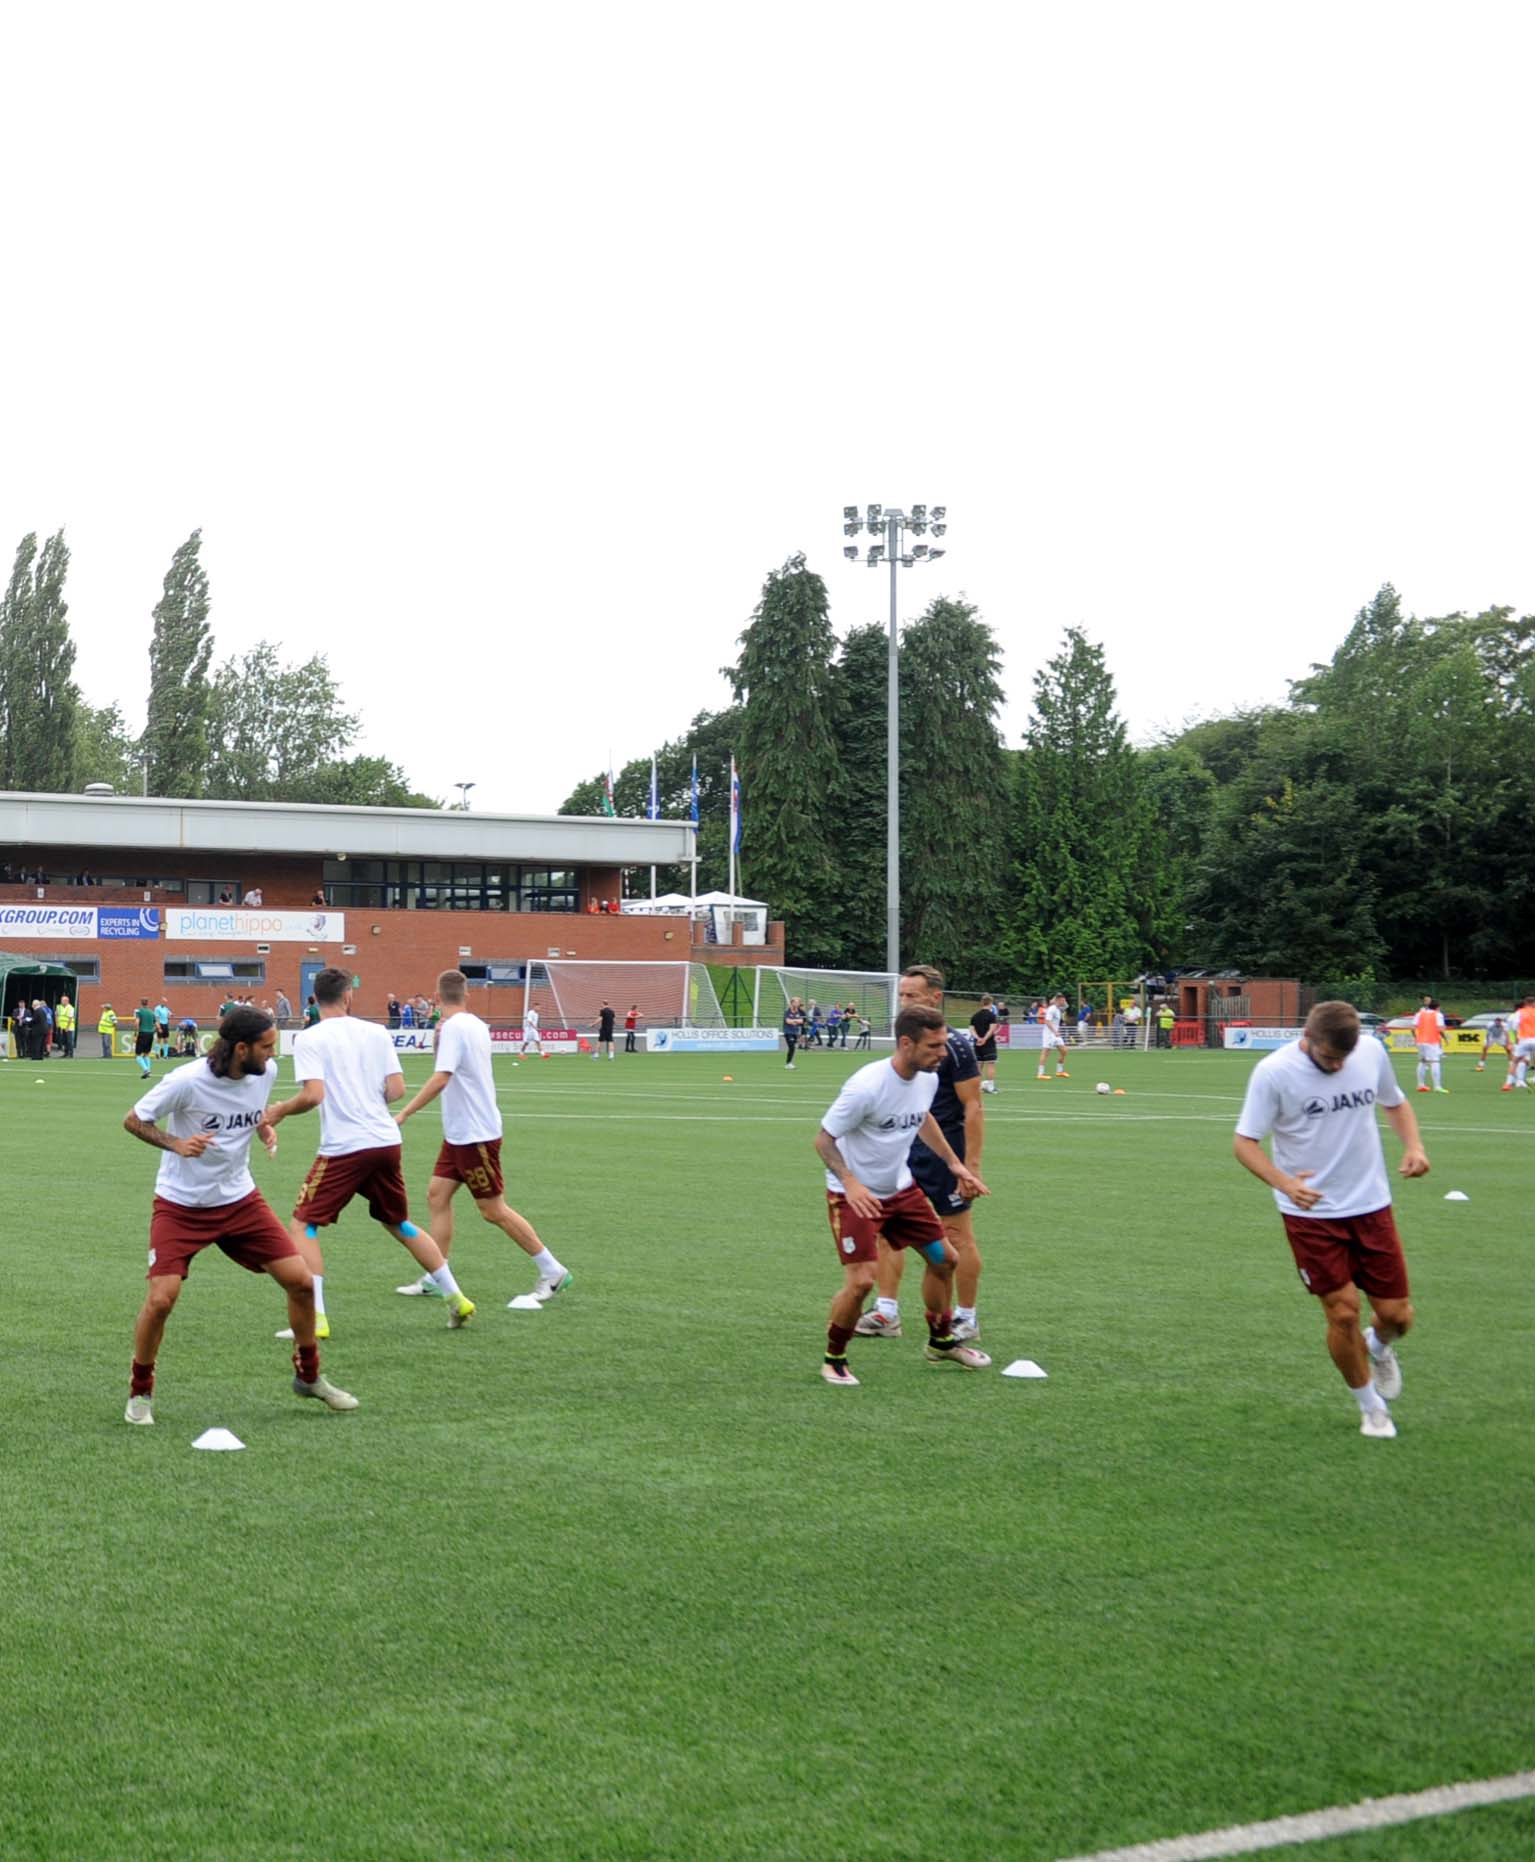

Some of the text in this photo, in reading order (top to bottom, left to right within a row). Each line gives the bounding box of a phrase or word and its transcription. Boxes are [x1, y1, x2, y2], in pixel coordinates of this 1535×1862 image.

[100, 918, 140, 927] EXPERTS IN
[180, 912, 282, 936] planethippo
[100, 927, 140, 936] RECYCLING
[1332, 1089, 1375, 1112] JAKO
